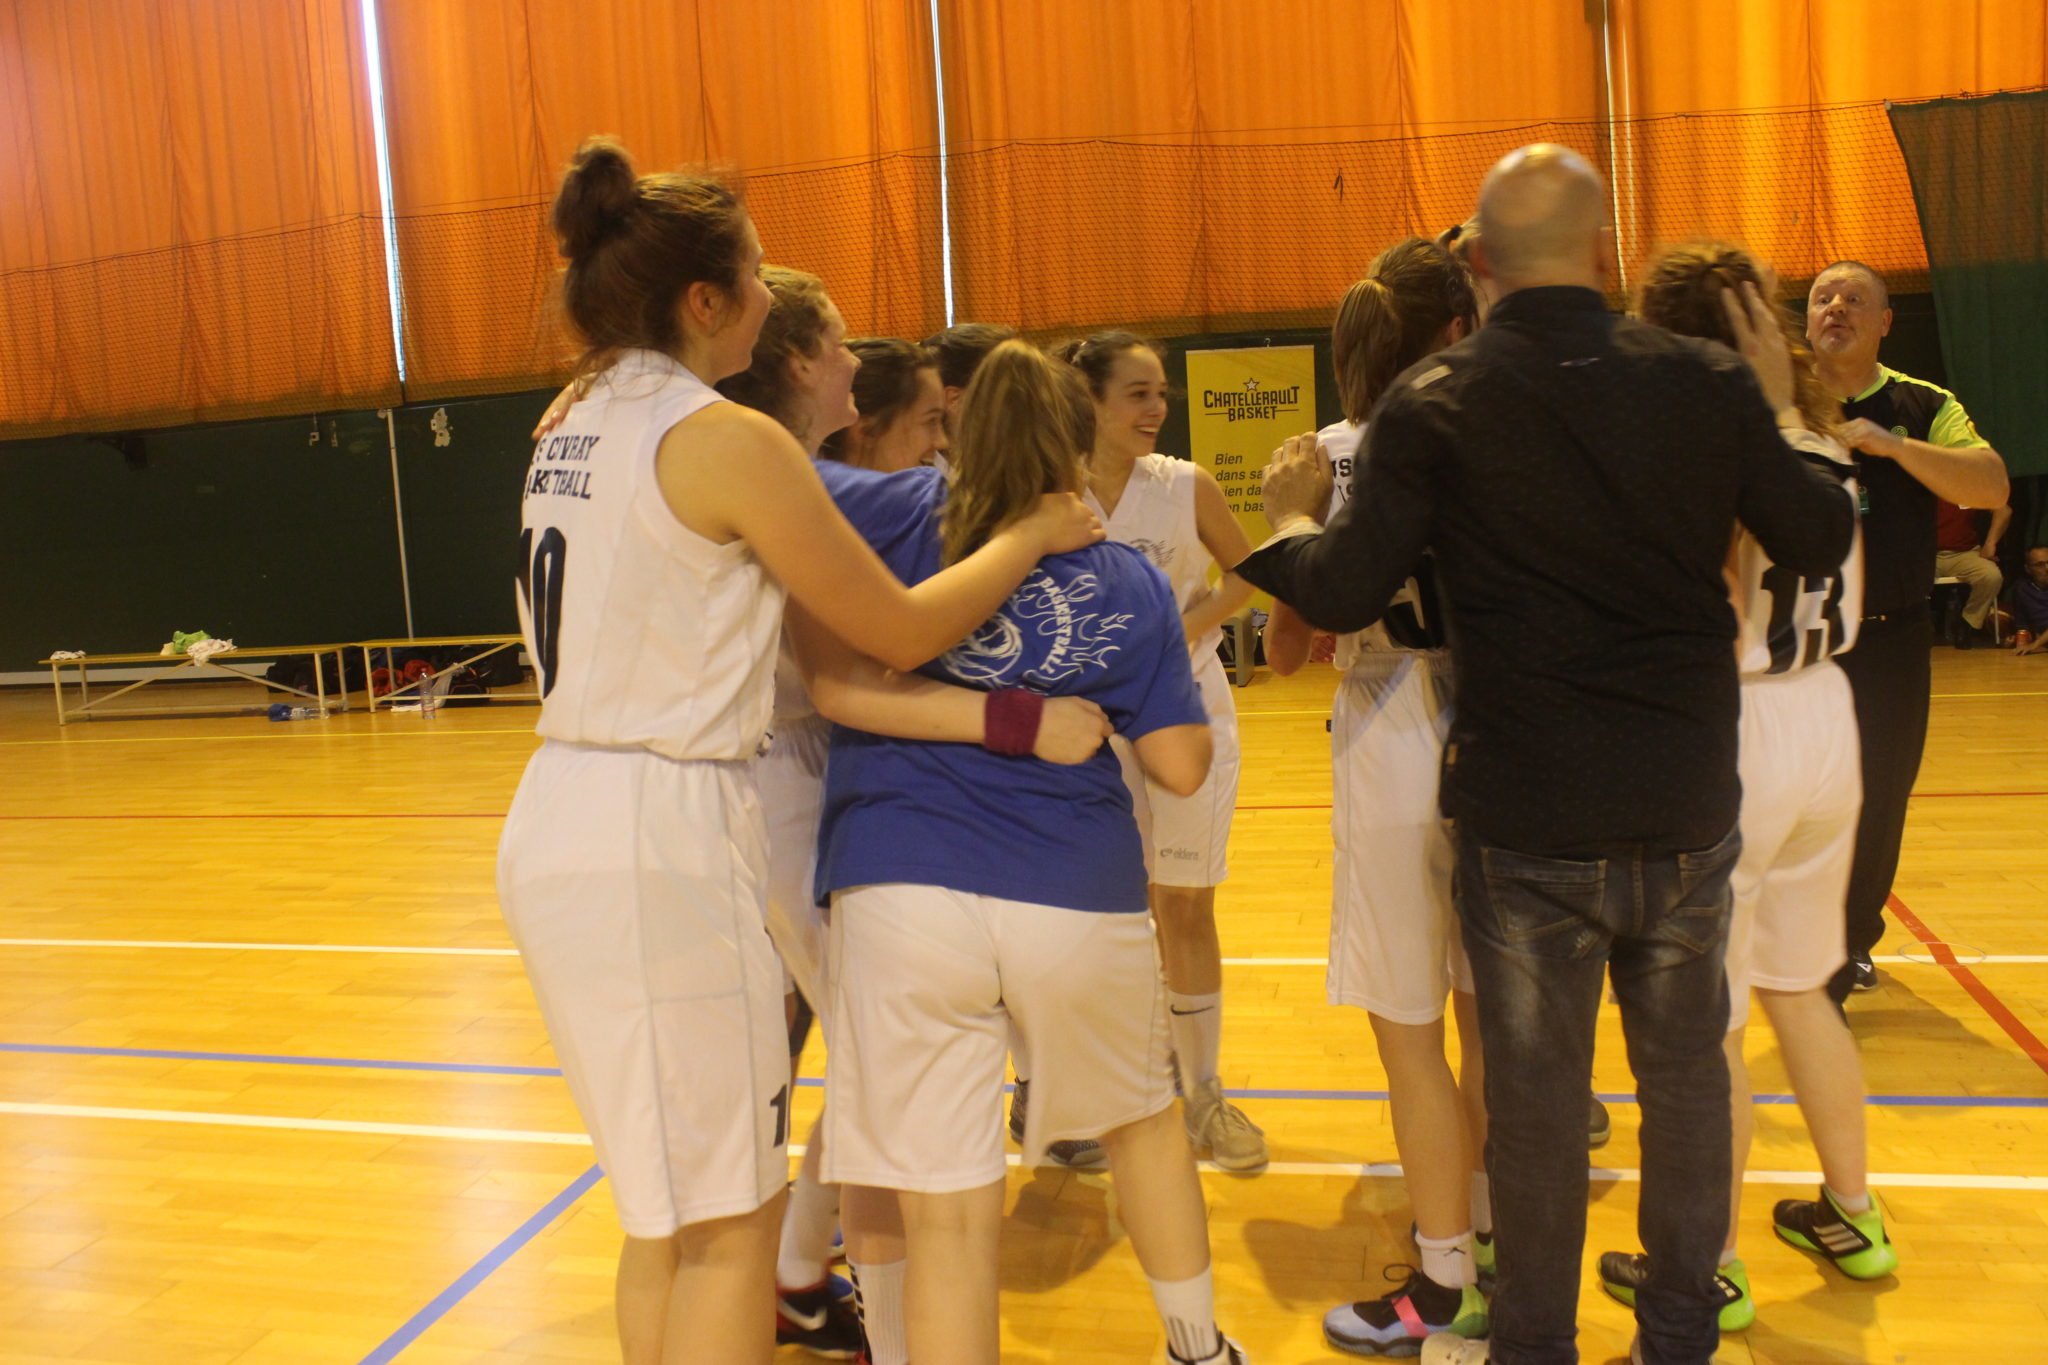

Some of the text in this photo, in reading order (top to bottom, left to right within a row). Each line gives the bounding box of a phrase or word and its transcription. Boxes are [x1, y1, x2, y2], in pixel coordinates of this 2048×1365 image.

[1203, 386, 1300, 408] CHATELLERAULT
[1228, 405, 1277, 422] BASKET
[1215, 453, 1243, 466] Bien
[1215, 470, 1246, 481] dans
[1223, 486, 1243, 497] ien
[1039, 576, 1072, 674] BASKETBALL
